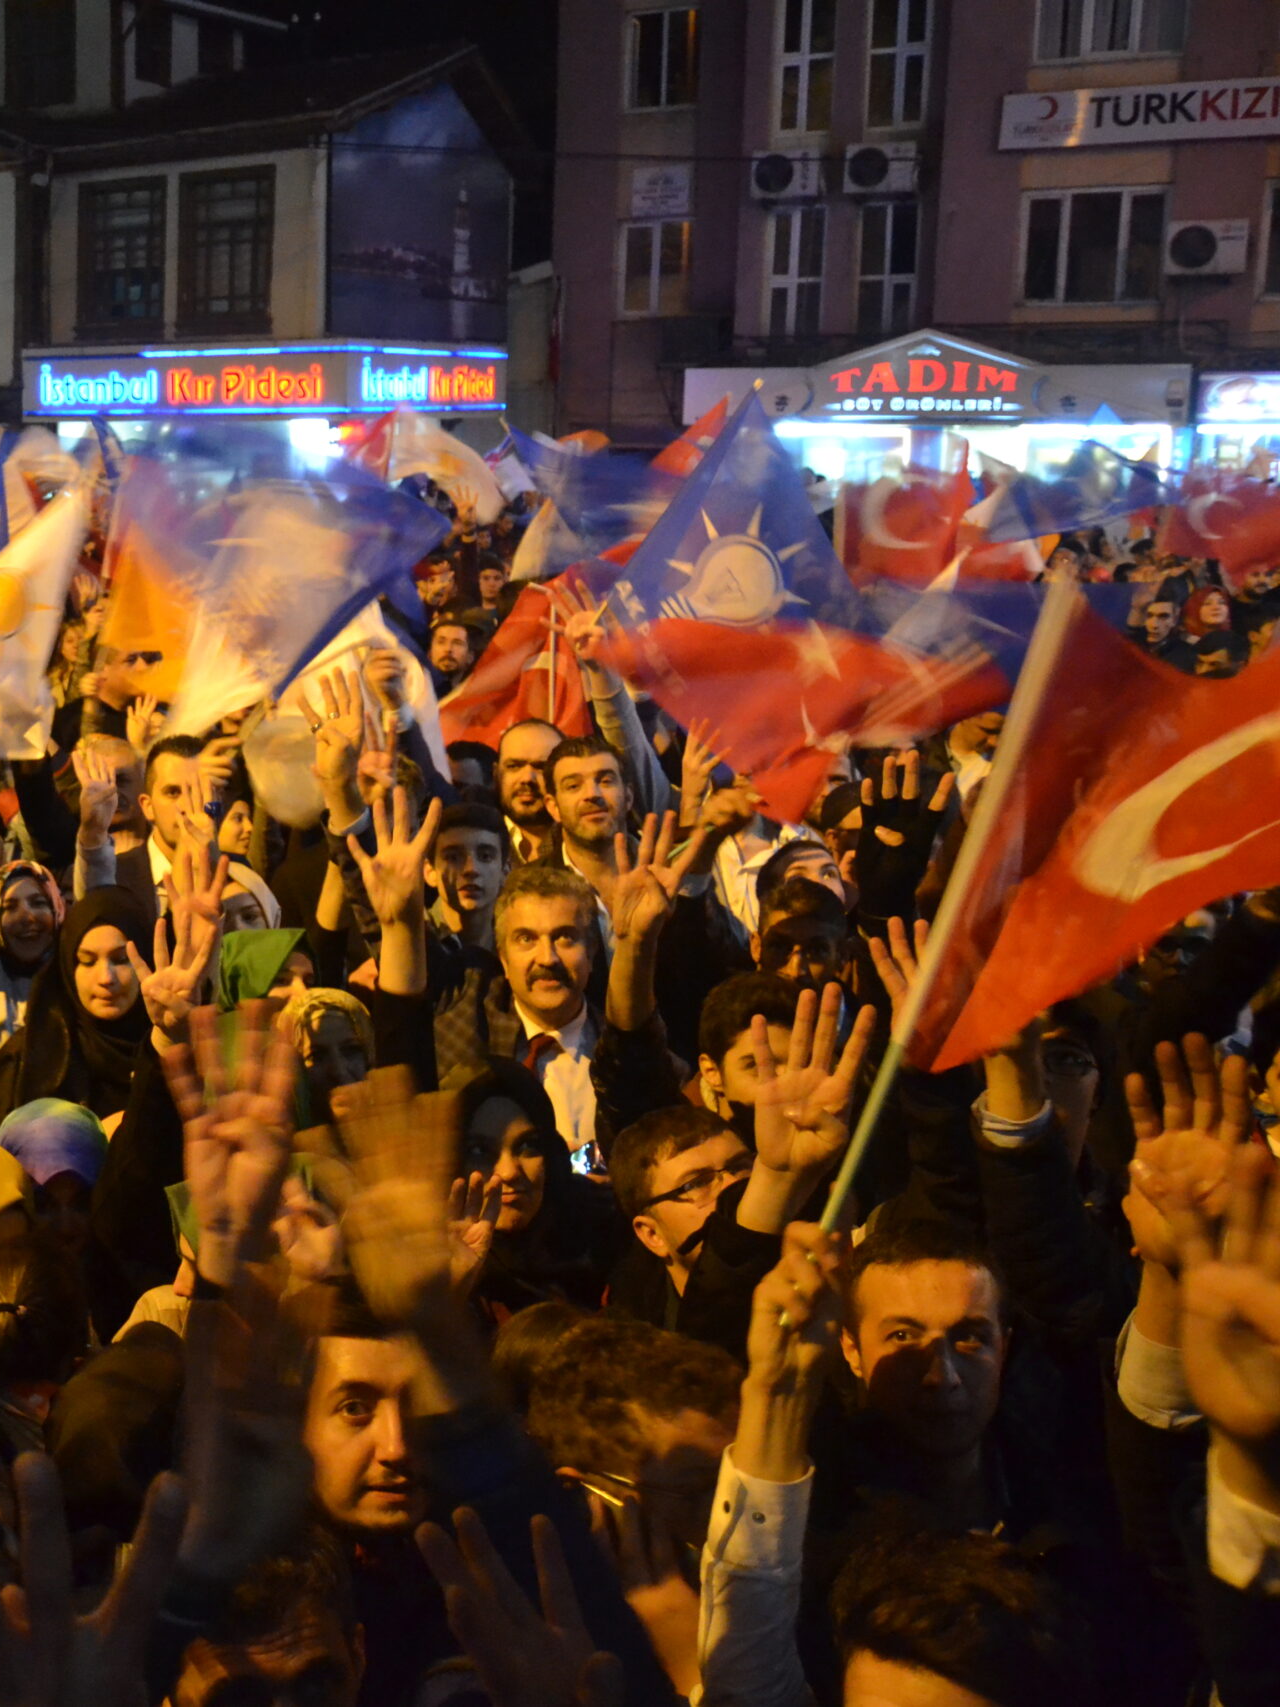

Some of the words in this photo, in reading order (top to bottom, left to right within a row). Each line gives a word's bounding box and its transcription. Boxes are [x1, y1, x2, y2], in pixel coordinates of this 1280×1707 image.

[39, 363, 159, 406] İstanbul
[166, 367, 215, 405] Kır
[221, 363, 323, 404] Pidesi
[362, 356, 428, 402] İstanbul
[829, 360, 1019, 392] TADIM
